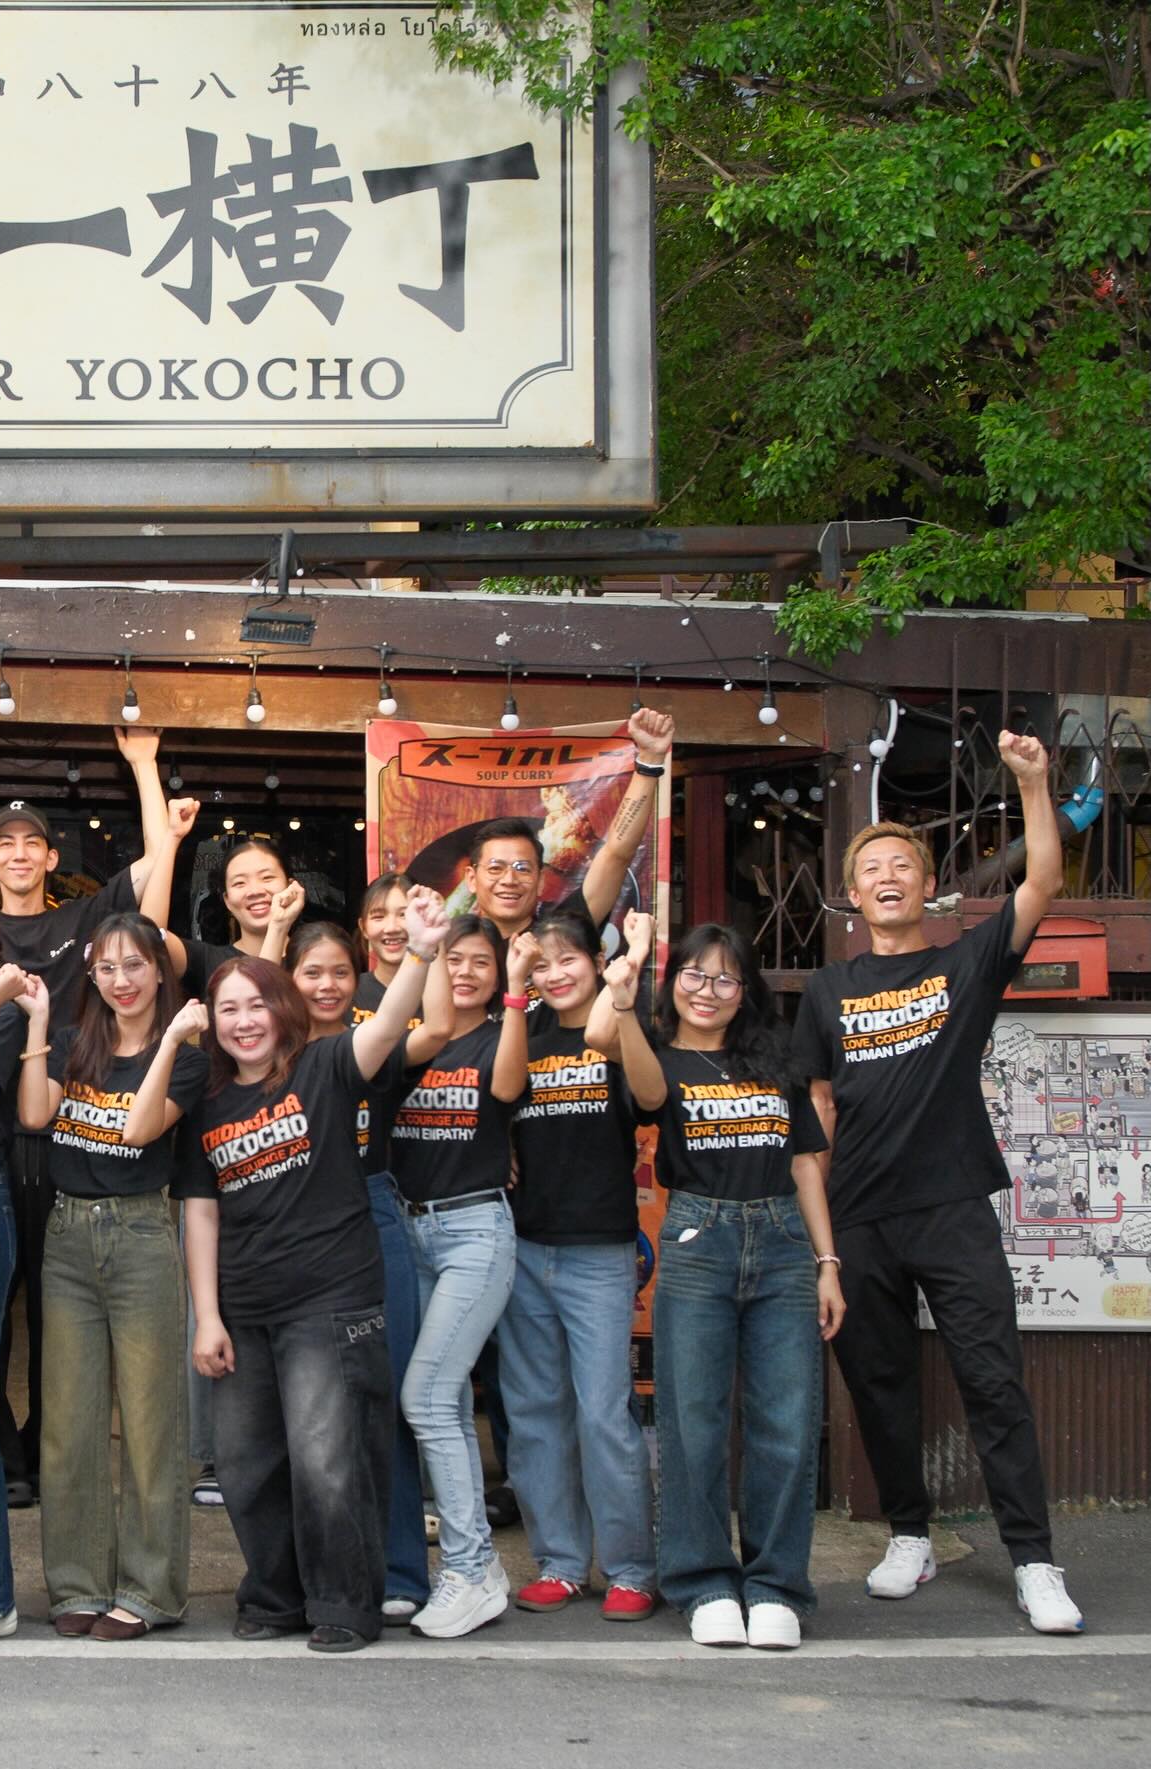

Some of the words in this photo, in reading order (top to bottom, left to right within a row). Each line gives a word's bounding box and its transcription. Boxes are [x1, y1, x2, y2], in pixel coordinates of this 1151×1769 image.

[300, 17, 386, 37] ทองหล่อ
[67, 357, 406, 402] YOKOCHO
[476, 770, 510, 781] SOUP
[512, 770, 555, 782] CURRY
[841, 975, 948, 1015] THONGLOR
[839, 989, 950, 1035] YOKOCHO
[843, 1036, 875, 1051] LOVE,
[875, 1023, 929, 1046] COURAGE
[845, 1044, 894, 1063] HUMAN
[582, 1089, 608, 1100] AND
[546, 1100, 609, 1117] EMPATHY
[454, 1115, 479, 1127] AND
[85, 1140, 144, 1159] EMPATHY
[208, 1112, 309, 1171] YOKOCHO
[686, 1136, 736, 1151] HUMAN
